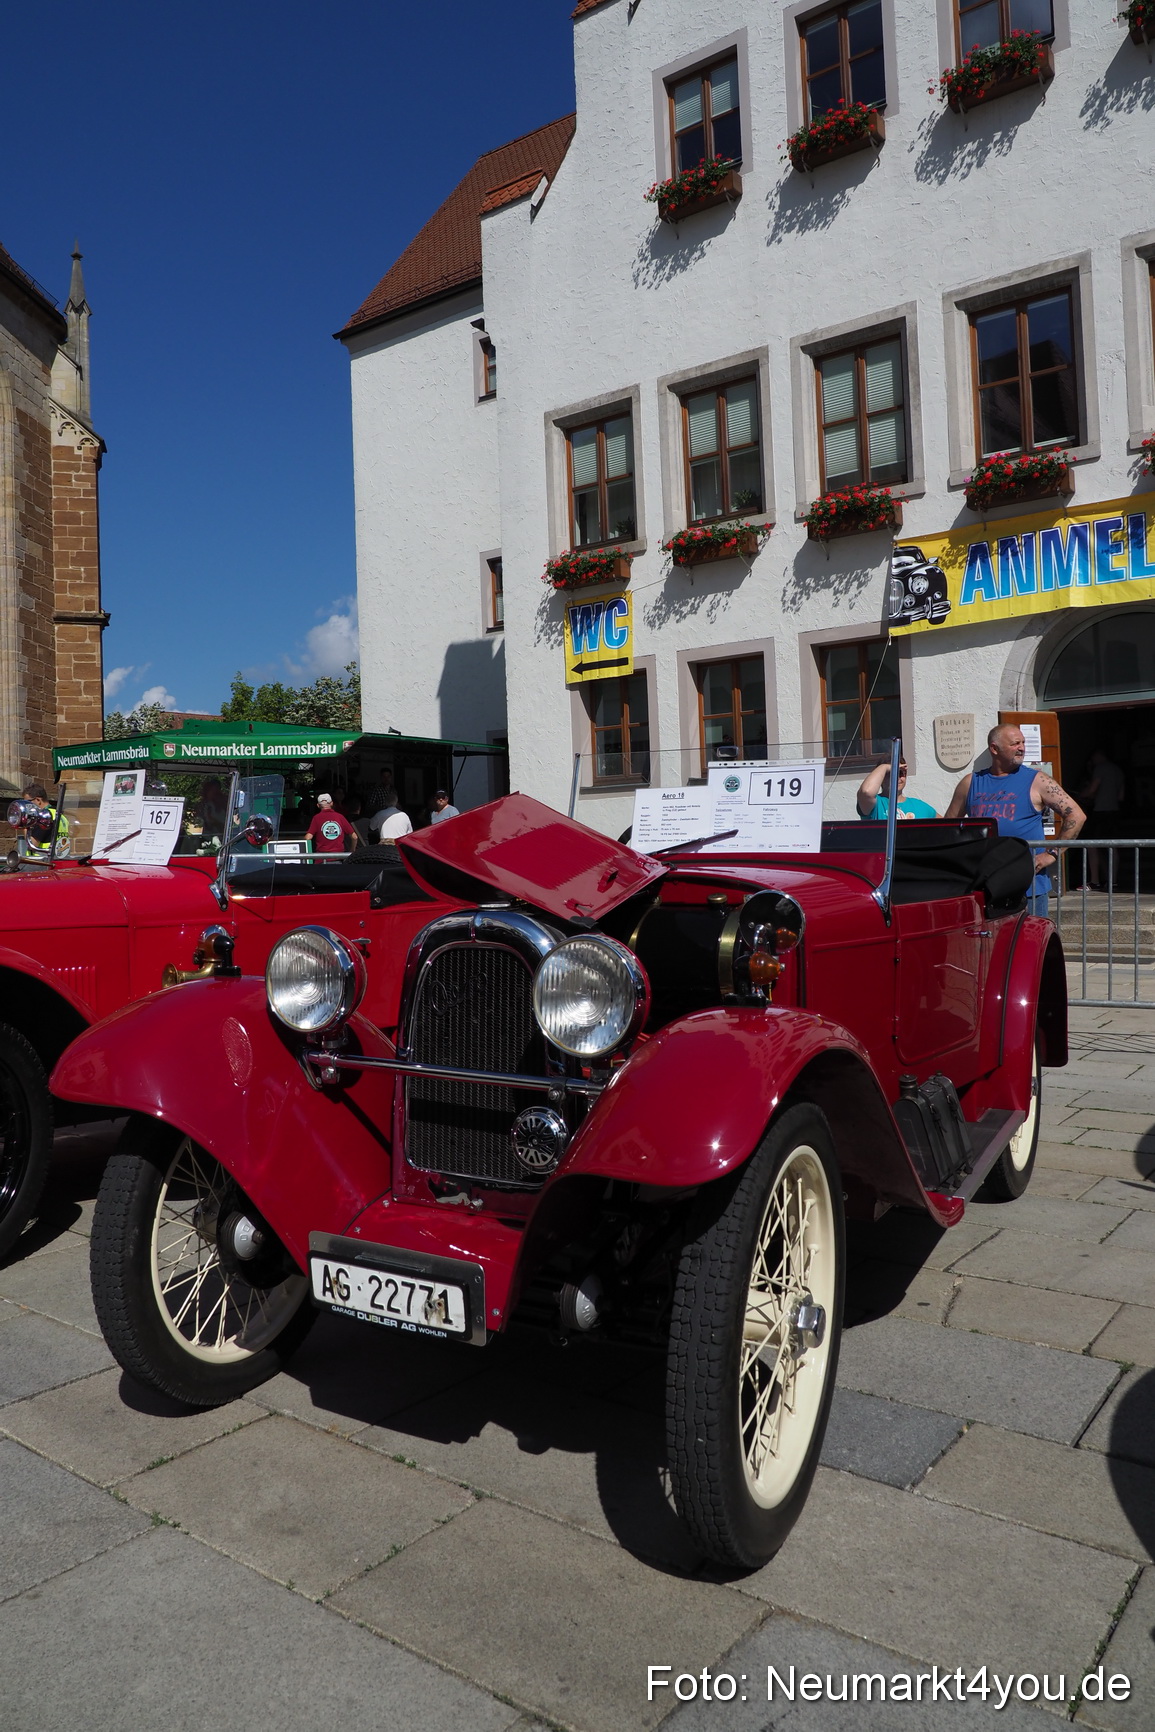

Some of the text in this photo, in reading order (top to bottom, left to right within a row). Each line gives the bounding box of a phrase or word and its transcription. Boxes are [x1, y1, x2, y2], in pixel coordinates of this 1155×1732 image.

[959, 512, 1155, 605] ANMEL
[568, 597, 628, 655] WC
[57, 746, 149, 767] Neumarkter Lammsbräu
[181, 741, 337, 757] Neumarkter Lammsbräu
[764, 778, 802, 797] 119
[150, 811, 170, 825] 167
[331, 1305, 356, 1317] GARAGE
[401, 1322, 417, 1332] AG
[418, 1326, 447, 1338] WOHLEN
